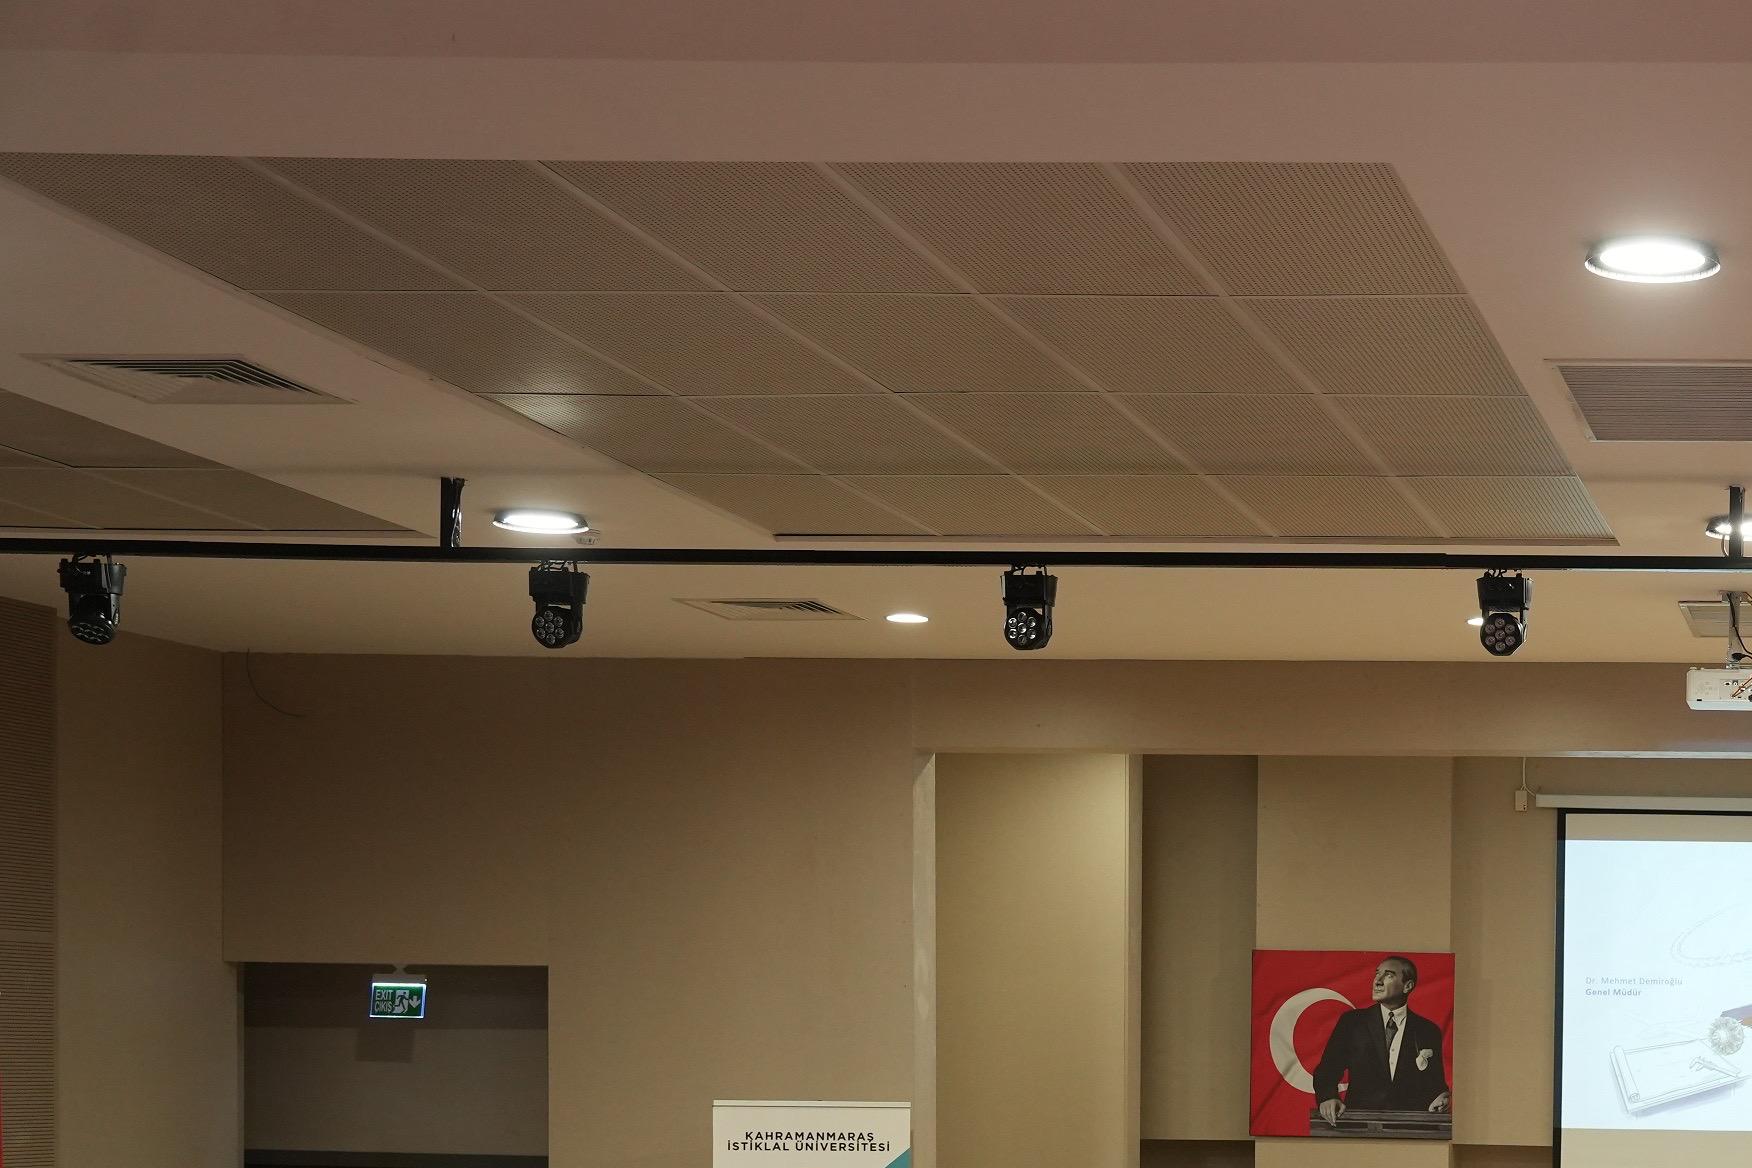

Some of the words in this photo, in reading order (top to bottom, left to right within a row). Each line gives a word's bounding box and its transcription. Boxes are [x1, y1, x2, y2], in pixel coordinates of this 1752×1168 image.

[1600, 977, 1636, 985] Mehmet
[376, 989, 394, 1001] EXIT
[1585, 988, 1610, 996] Genel
[1613, 988, 1642, 996] Müdür
[745, 1131, 874, 1143] KAHRAMANMARAŞ
[727, 1140, 790, 1151] İSTİKLAL
[795, 1140, 890, 1152] ÜNİVERSİTESİ
